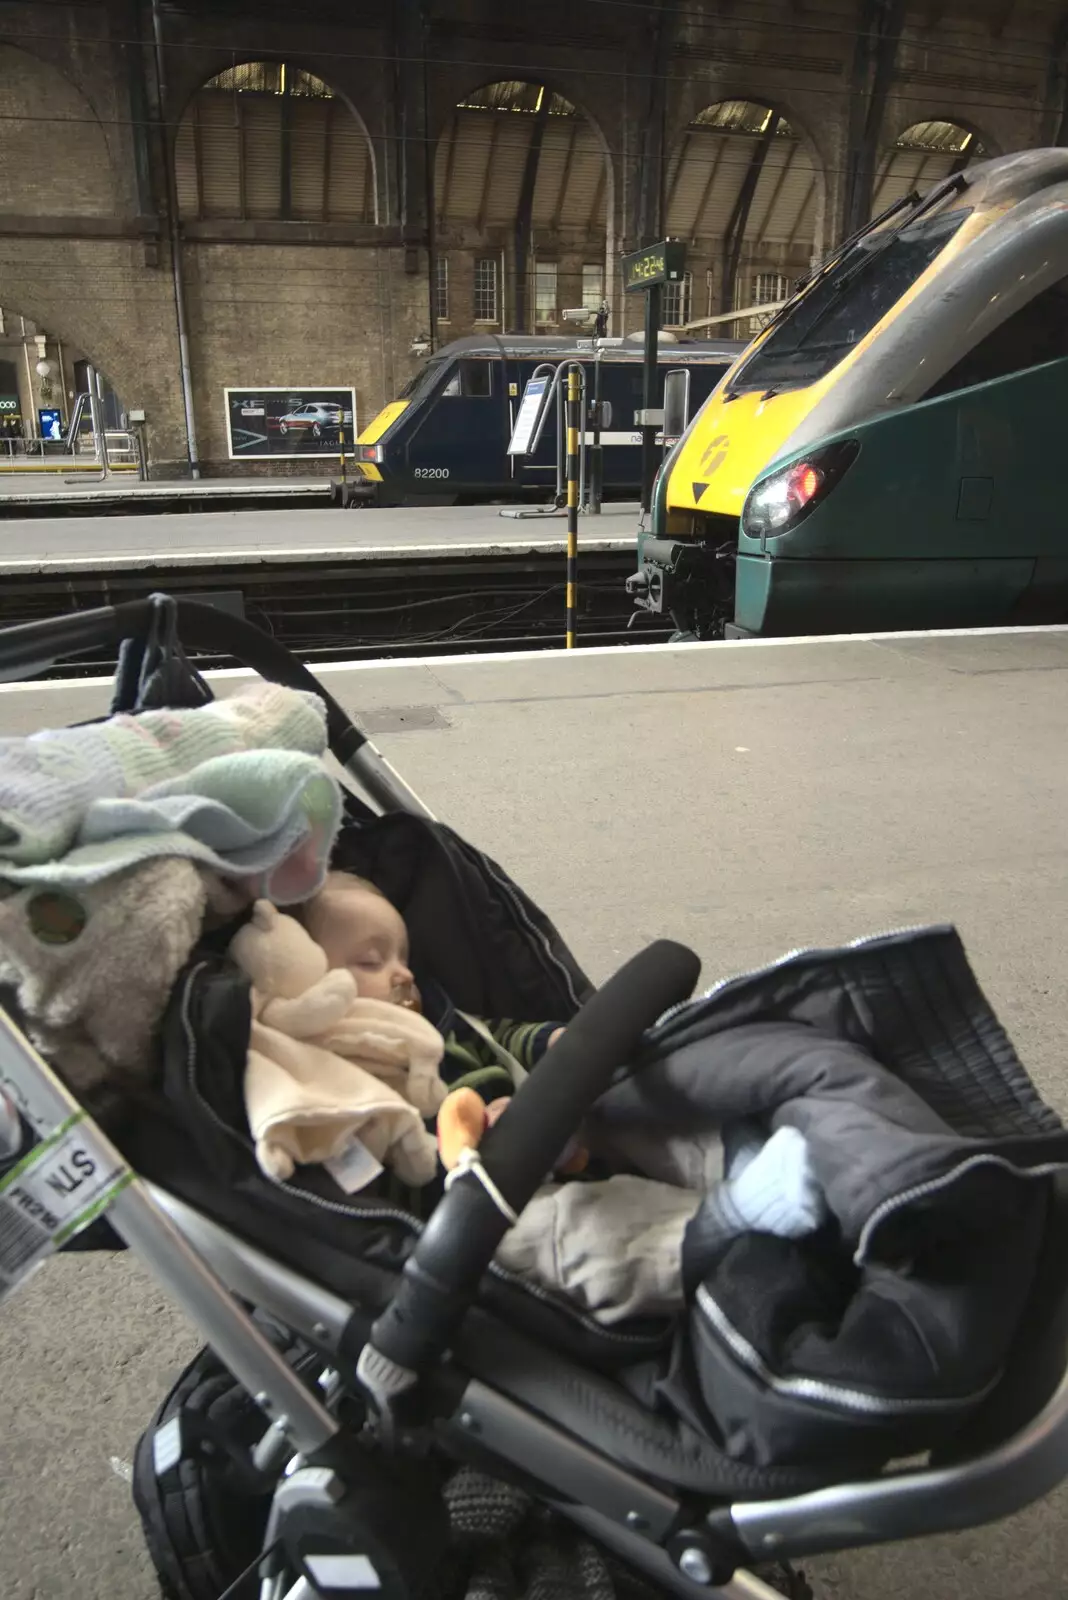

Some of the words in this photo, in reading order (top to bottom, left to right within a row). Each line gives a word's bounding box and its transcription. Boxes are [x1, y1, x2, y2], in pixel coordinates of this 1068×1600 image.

[232, 399, 265, 408] XF
[414, 468, 450, 479] 82200
[45, 1149, 96, 1198] STN
